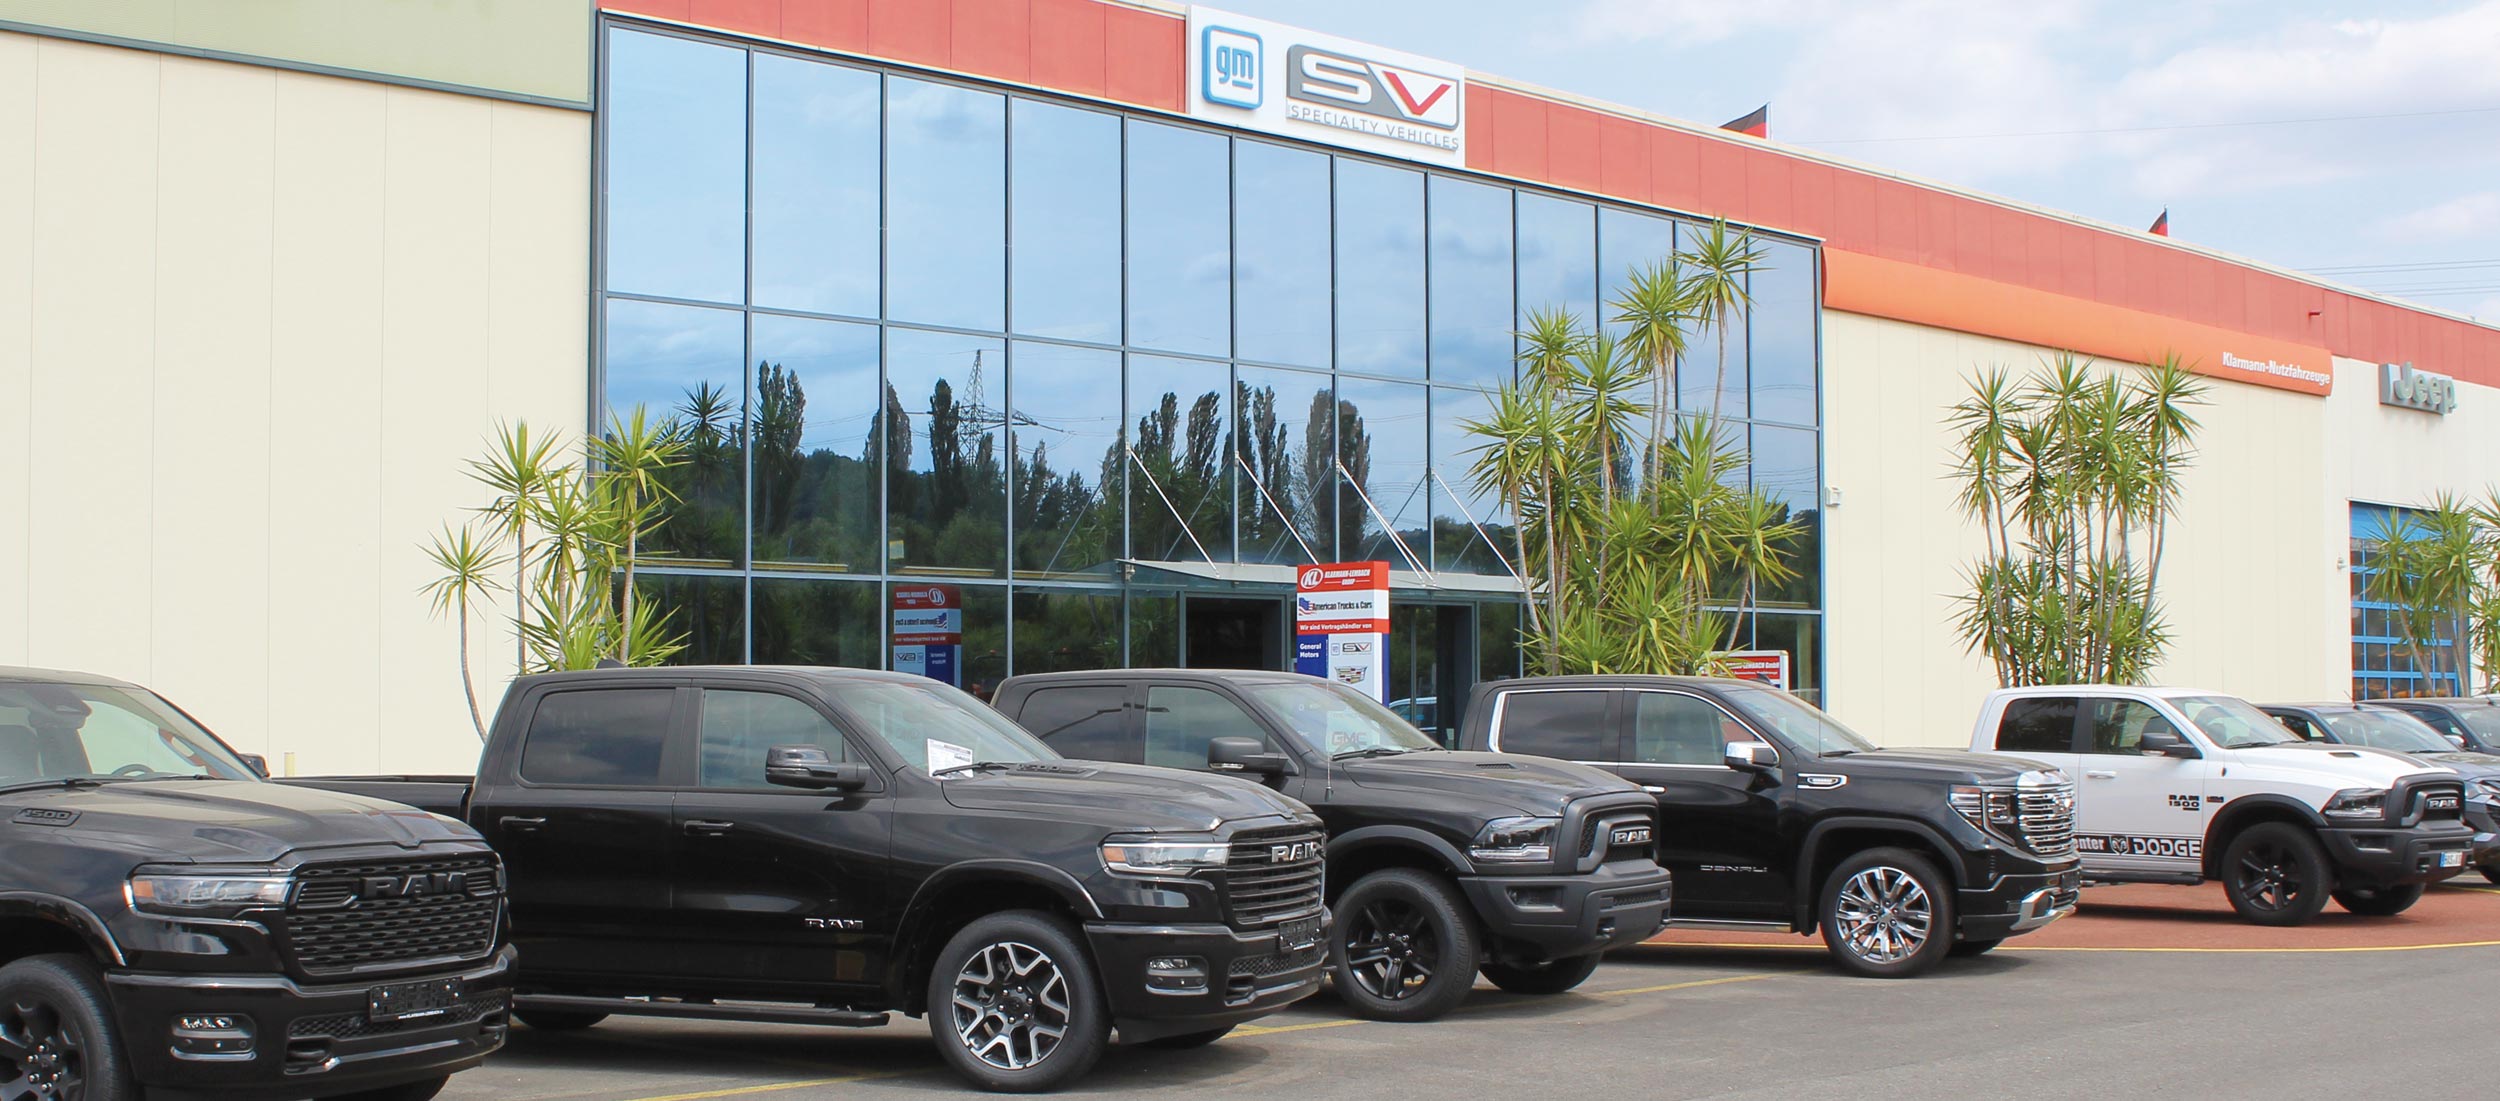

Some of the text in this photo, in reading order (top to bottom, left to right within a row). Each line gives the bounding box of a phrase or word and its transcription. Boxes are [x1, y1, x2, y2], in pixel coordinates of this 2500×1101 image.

[1300, 52, 1454, 118] SV
[1290, 105, 1460, 150] SPECIALTY VEHICLES
[2222, 351, 2331, 386] Klarmann-Nutzfahrzeuge
[2393, 361, 2455, 415] Jeep
[1312, 602, 1337, 611] American
[1338, 601, 1355, 610] Trucks
[1360, 600, 1372, 609] Cars
[2168, 800, 2200, 808] 1500
[2428, 799, 2459, 809] RAM
[1614, 830, 1650, 843] RAM
[2073, 838, 2202, 857] enter DODGE
[1700, 865, 1768, 873] DENALI
[362, 872, 467, 898] RAM
[804, 918, 863, 929] RAM
